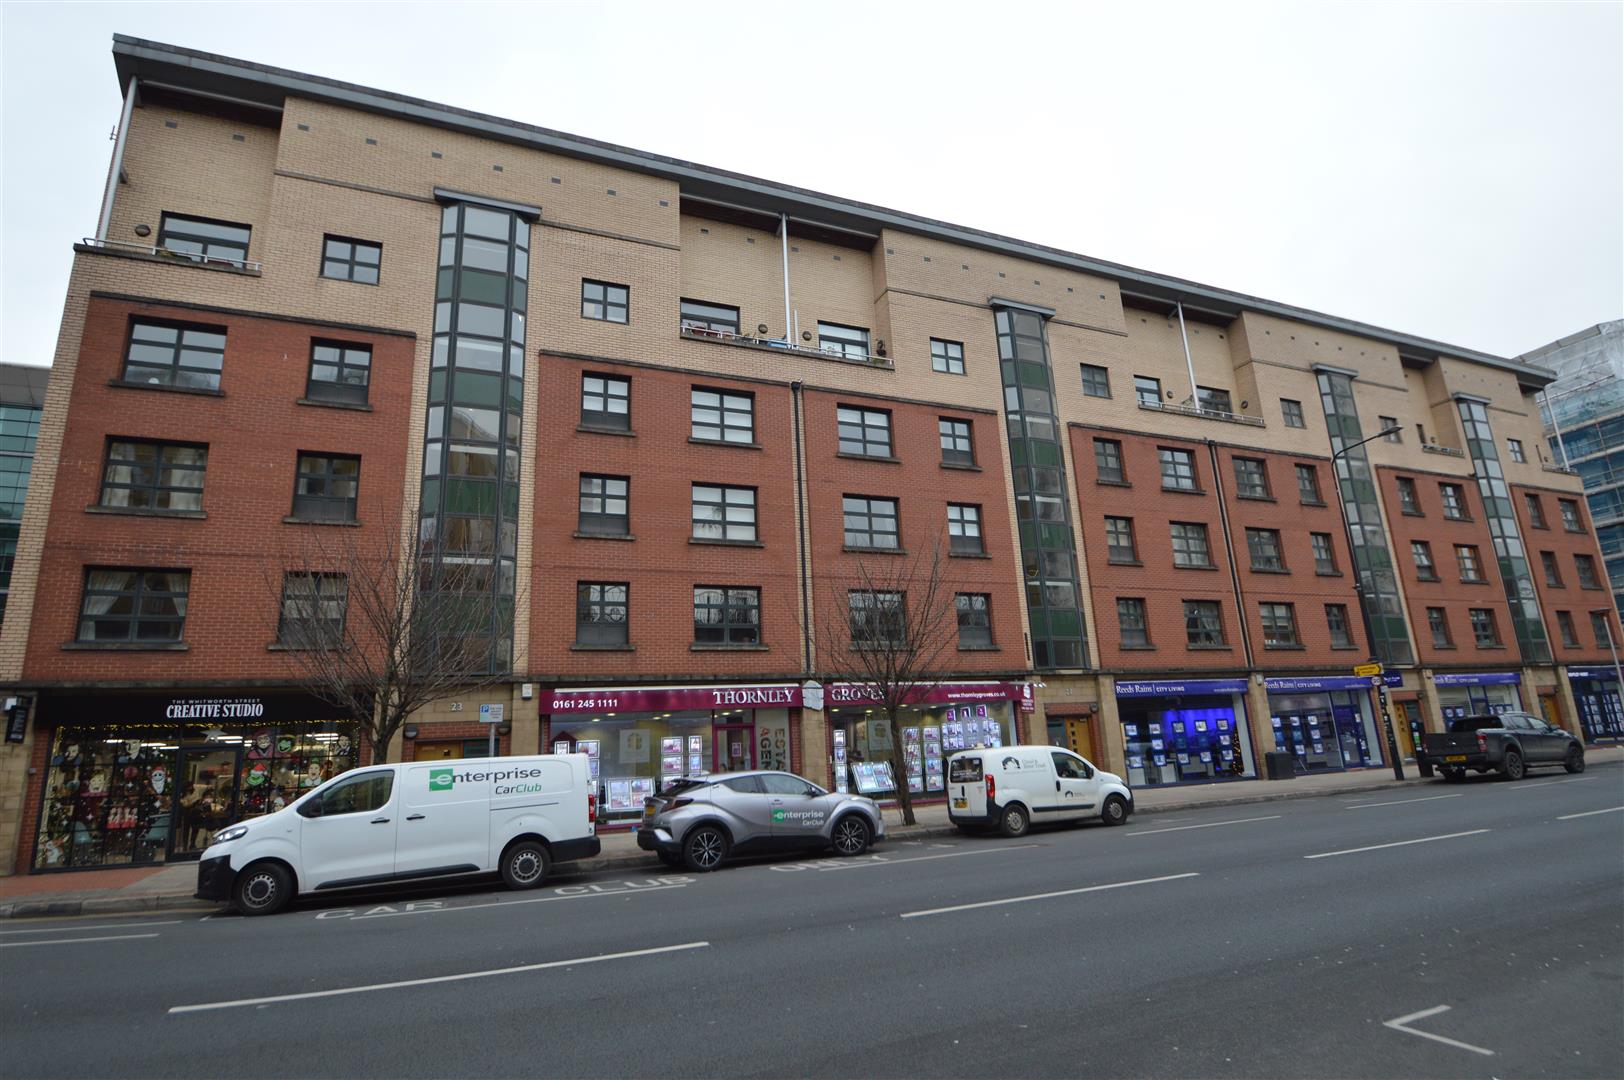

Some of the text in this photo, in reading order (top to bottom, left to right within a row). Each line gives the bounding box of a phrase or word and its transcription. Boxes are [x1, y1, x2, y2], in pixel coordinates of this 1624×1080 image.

[1116, 685, 1134, 694] Reeds
[1135, 684, 1152, 693] Rains
[712, 689, 794, 704] THORNLEY
[451, 703, 463, 711] 23
[553, 699, 618, 709] 0161 245 1111
[166, 703, 264, 718] CREATIVE STUDIO
[430, 768, 541, 786] enterprise
[495, 783, 542, 795] CarClub
[774, 809, 824, 820] enterprise
[802, 818, 825, 826] CarClub
[554, 876, 696, 896] CLUB
[315, 899, 447, 920] CAR
